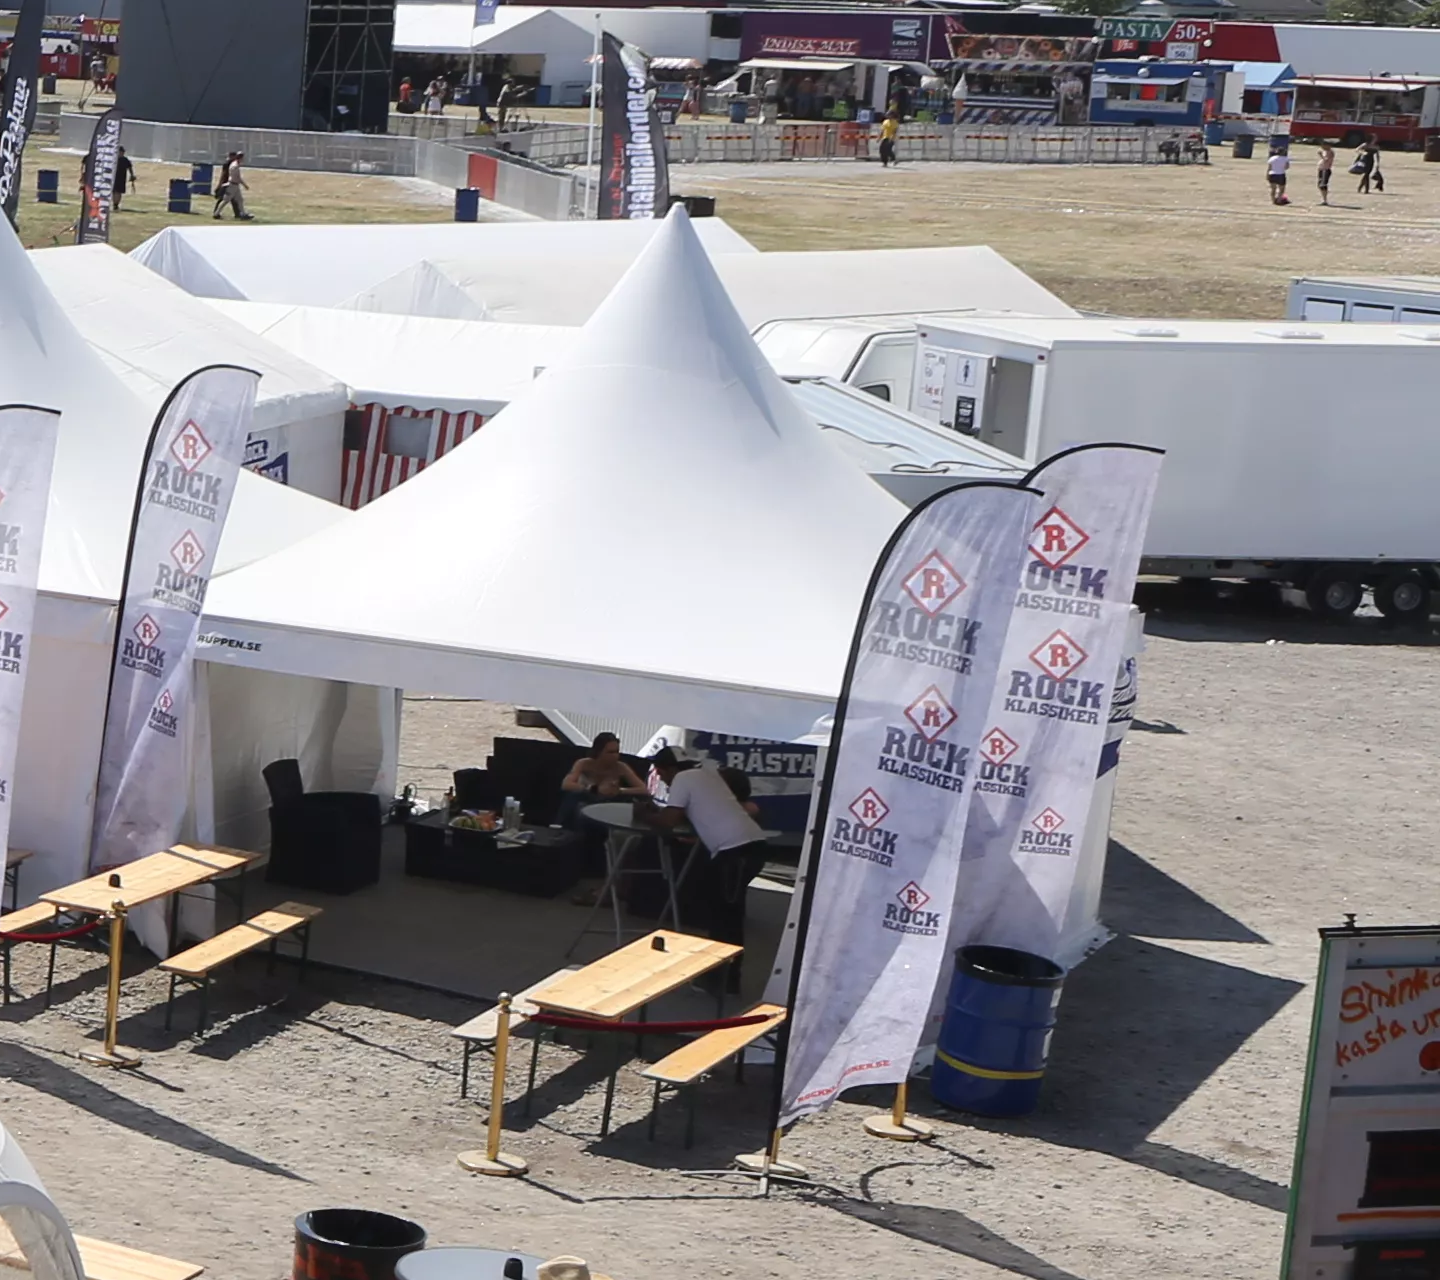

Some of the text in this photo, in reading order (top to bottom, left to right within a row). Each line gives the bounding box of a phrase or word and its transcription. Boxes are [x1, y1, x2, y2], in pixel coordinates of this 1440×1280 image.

[1099, 21, 1164, 40] PASTA
[761, 35, 858, 55] INDISK MAT
[182, 434, 199, 460] R
[151, 460, 223, 506] ROCK
[148, 490, 217, 523] KLASSIKER
[1042, 524, 1068, 552] R
[181, 541, 195, 564] R
[155, 562, 210, 603] ROCK
[920, 567, 947, 599] R
[1025, 559, 1109, 600] OCK
[1015, 592, 1102, 619] ASSIKER
[141, 622, 153, 639] R
[873, 600, 983, 656] ROCK
[122, 638, 166, 669] ROCK
[196, 633, 262, 652] RUPPEN.SE
[869, 634, 973, 676] KLASSIKER
[1048, 643, 1071, 668] R
[1007, 670, 1106, 710] ROCK
[150, 707, 178, 731] ROCK
[922, 700, 942, 727] R
[1003, 697, 1100, 726] KLASSIKER
[881, 725, 972, 777] ROCK
[989, 737, 1005, 756] R
[726, 747, 818, 775] BÄSTA
[877, 755, 964, 794] KLASSIKER
[980, 760, 1031, 786] OCK
[973, 781, 1027, 798] ASSIKER
[862, 798, 878, 819] R
[1043, 814, 1056, 828] R
[832, 817, 900, 856] ROCK
[1020, 829, 1075, 849] ROCK
[830, 839, 894, 868] KLASSIKER
[1018, 844, 1071, 857] KLASSIKER
[906, 889, 919, 904] R
[882, 919, 939, 937] KLASSIKER
[884, 903, 941, 928] ROCK
[1335, 1014, 1407, 1069] kasta
